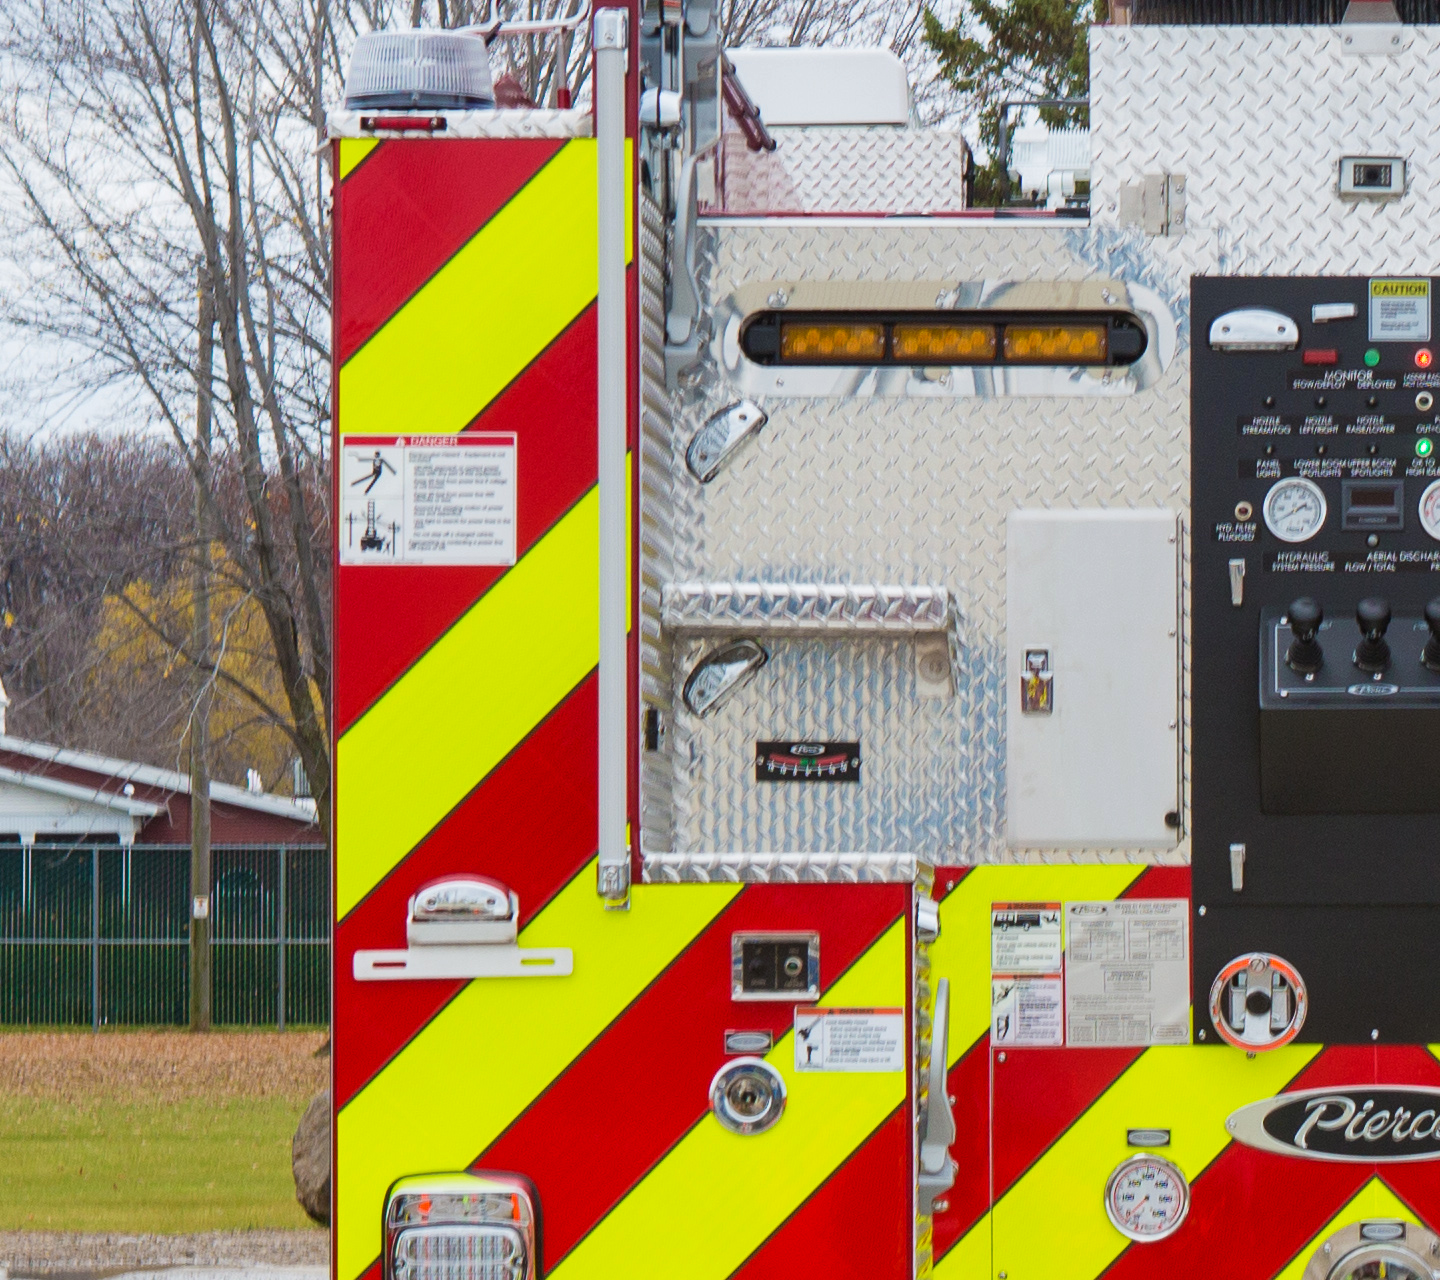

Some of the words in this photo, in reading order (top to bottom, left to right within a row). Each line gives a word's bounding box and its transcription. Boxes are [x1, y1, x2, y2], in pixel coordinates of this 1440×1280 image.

[1372, 283, 1427, 295] CAUTION
[1324, 370, 1373, 381] MONITOR
[1357, 379, 1397, 389] DEPLOYED
[1253, 415, 1281, 425] NOZZLE
[1305, 415, 1333, 425] NOZZLE
[1357, 415, 1385, 425] NOZZLE
[410, 437, 458, 446] DANGER
[1277, 551, 1329, 563] HYDRAULIC
[1366, 551, 1398, 562] AERIAL
